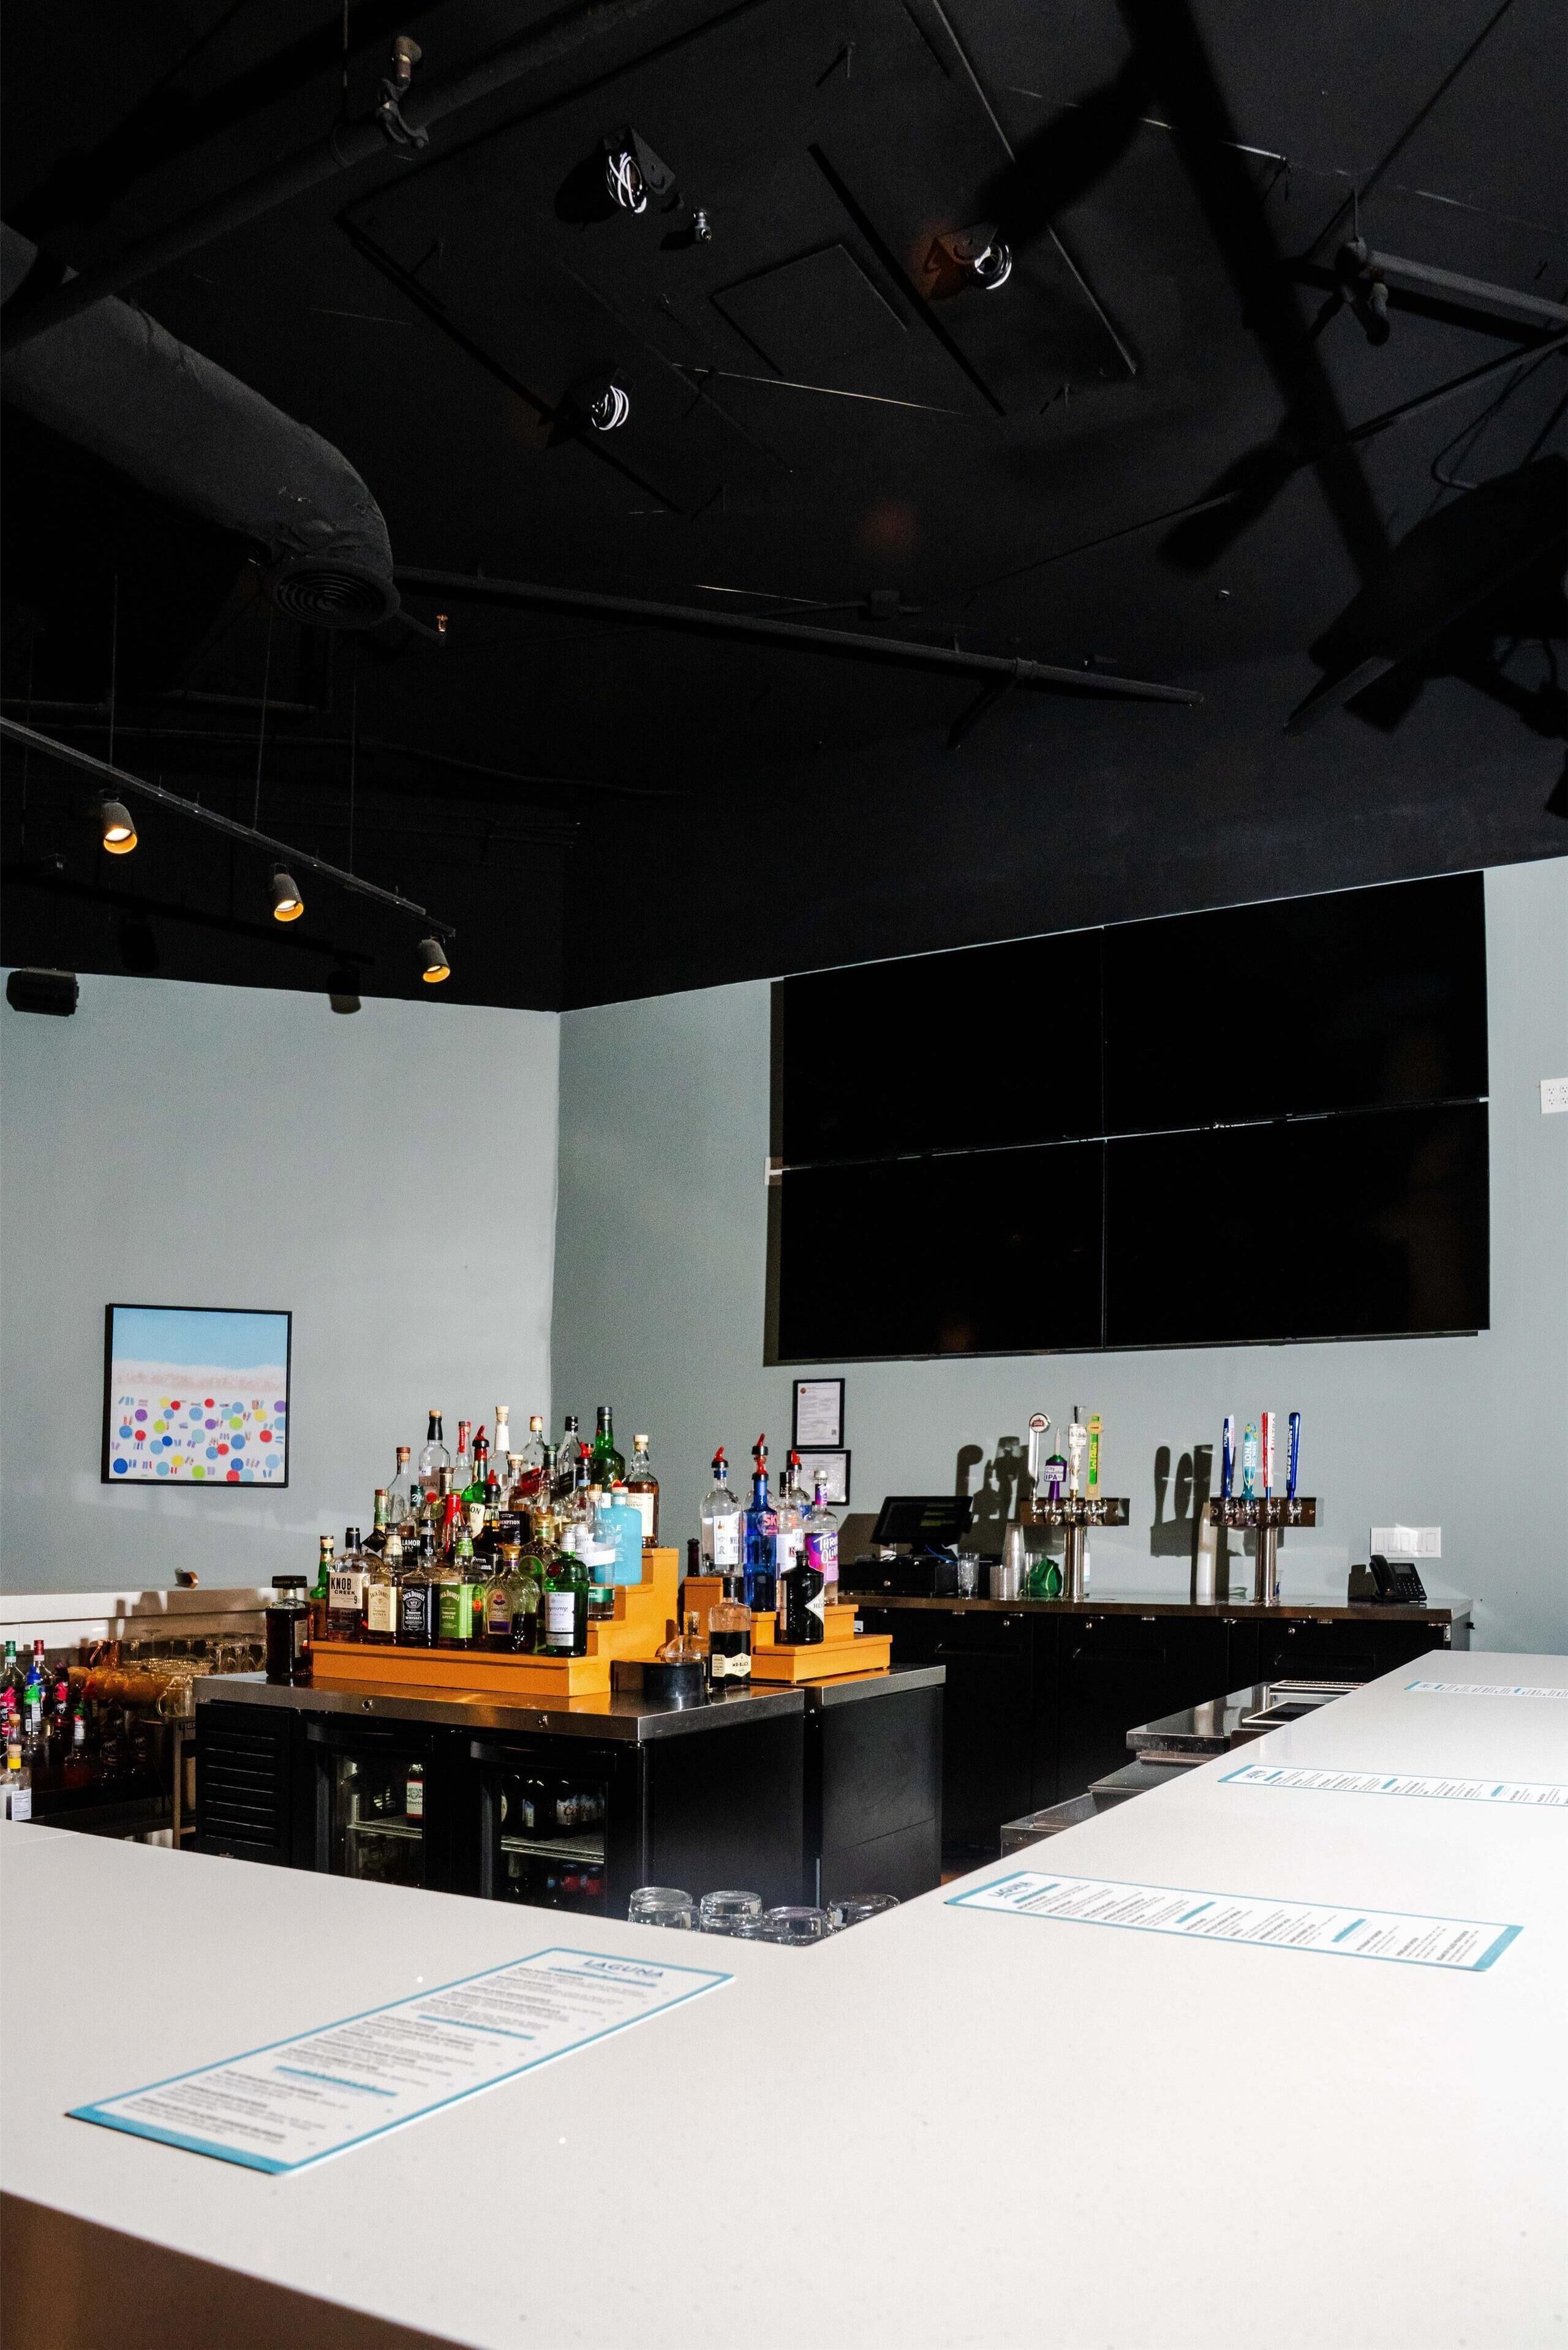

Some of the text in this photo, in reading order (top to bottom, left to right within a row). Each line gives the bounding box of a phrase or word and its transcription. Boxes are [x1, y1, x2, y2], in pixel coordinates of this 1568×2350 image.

[764, 1515, 777, 1526] SK
[331, 1577, 352, 1590] KNOB
[354, 1595, 358, 1604] 9
[402, 1592, 412, 1601] JACK
[583, 1959, 664, 1978] LAGUNA
